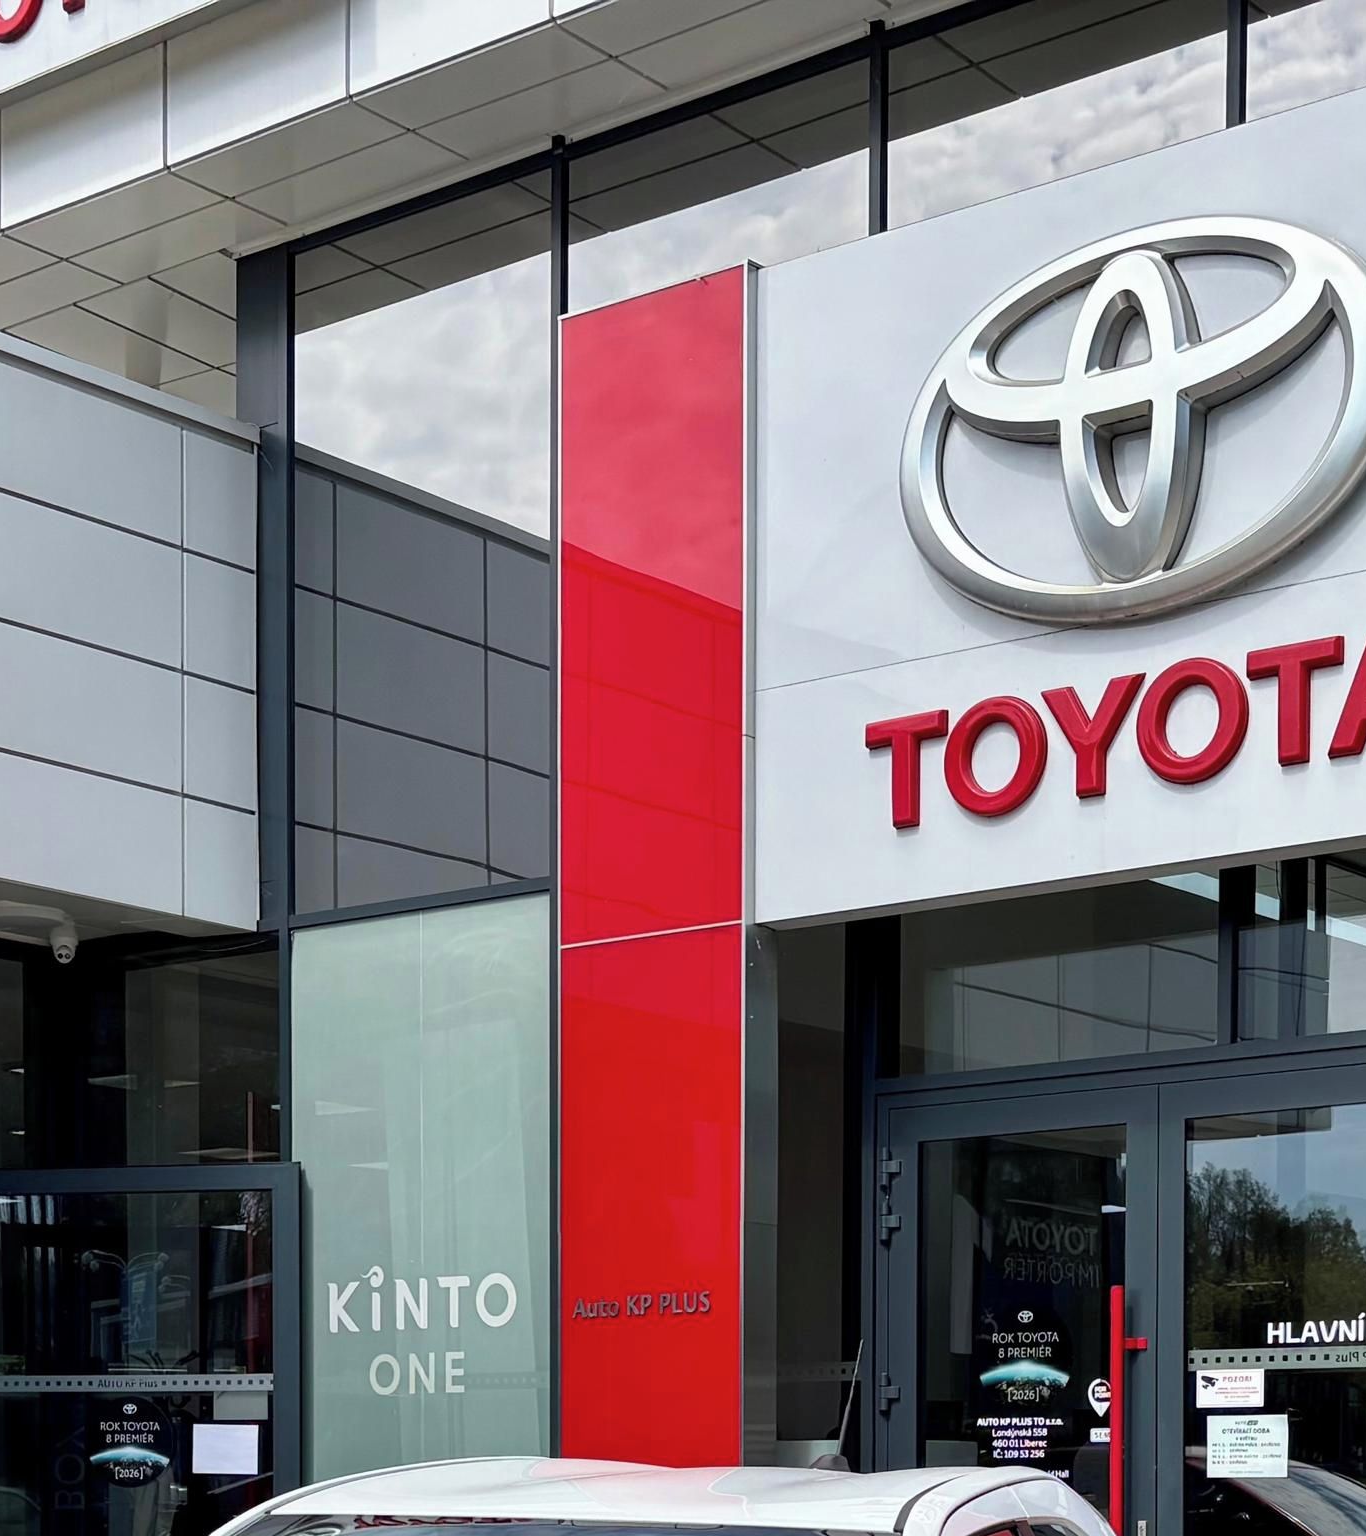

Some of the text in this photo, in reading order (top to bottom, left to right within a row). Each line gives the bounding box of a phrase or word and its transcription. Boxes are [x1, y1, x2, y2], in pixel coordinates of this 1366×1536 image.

[572, 1290, 712, 1319] Auto KP PLUS
[1267, 1312, 1365, 1344] HLAVNÍ
[992, 1332, 1060, 1344] ROK TOYOTA
[998, 1345, 1052, 1358] 8 PREMIÉR
[369, 1351, 465, 1396] ONE
[100, 1421, 160, 1431] ROK TOYOTA
[977, 1417, 999, 1427] AUTO
[1000, 1417, 1011, 1426] KP
[1011, 1417, 1032, 1426] PLUS
[1033, 1417, 1045, 1426] TO
[106, 1432, 154, 1443] 8 PREMIÉR
[992, 1439, 1048, 1447] 460 01 Liberec
